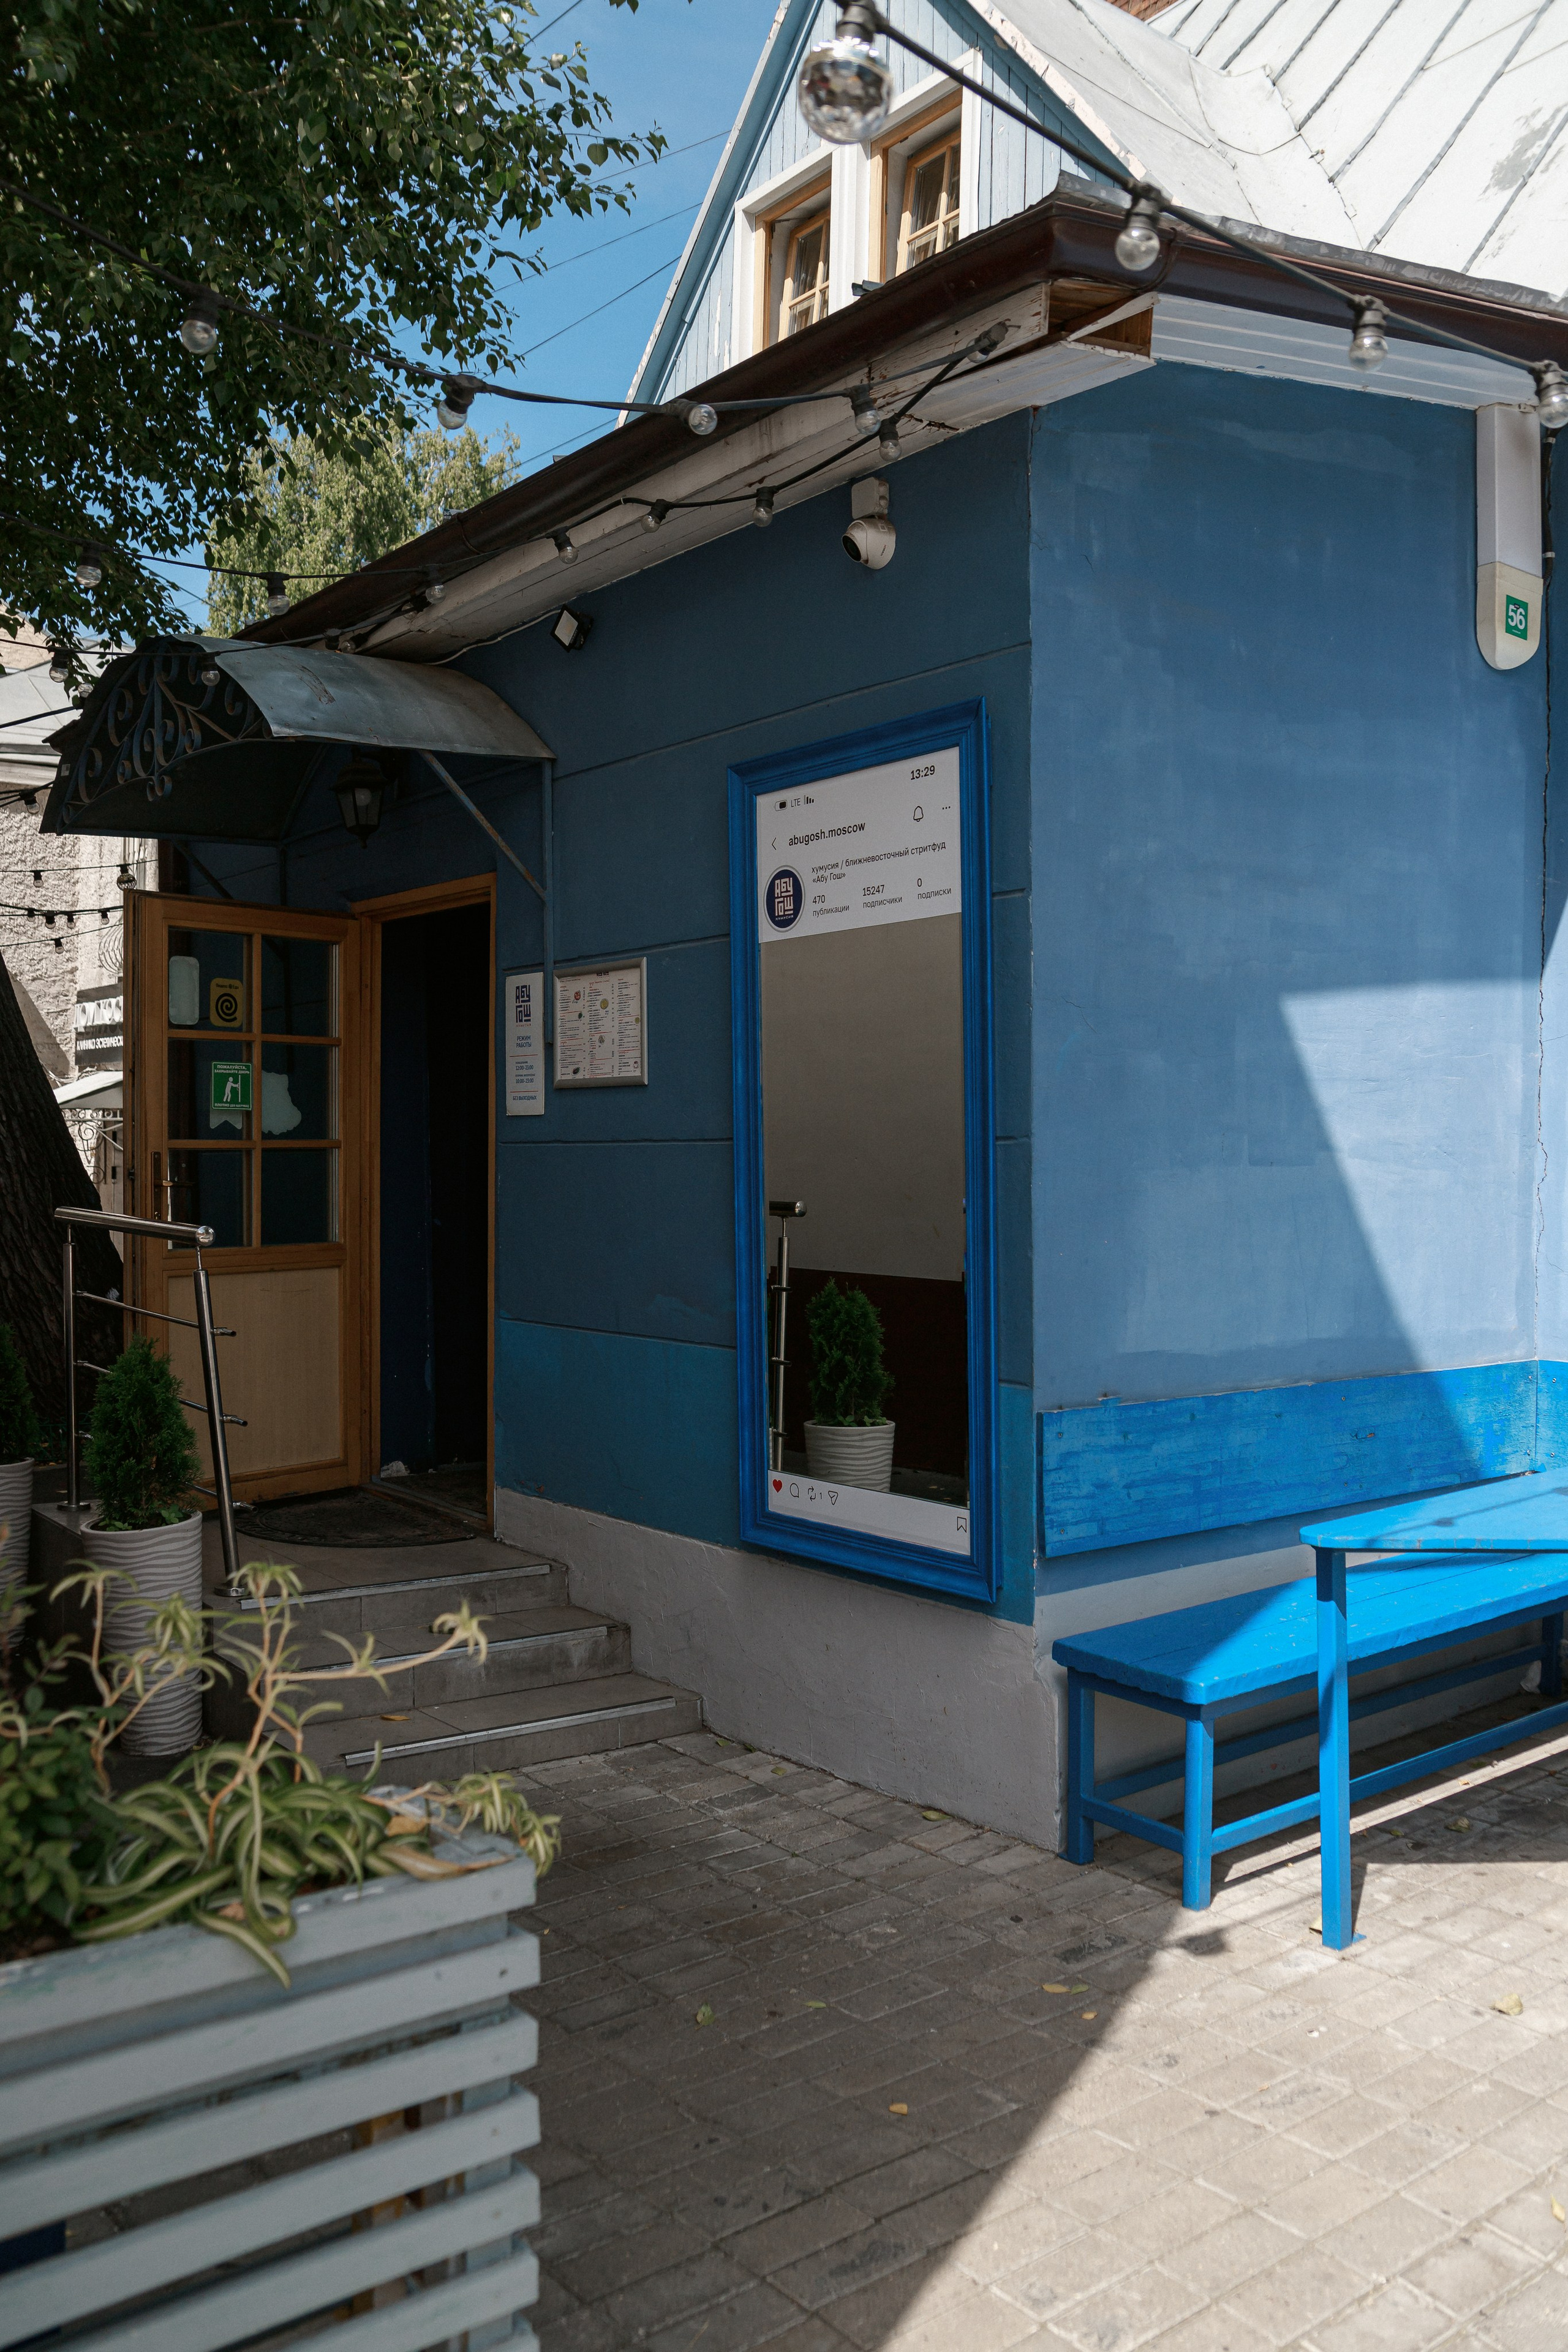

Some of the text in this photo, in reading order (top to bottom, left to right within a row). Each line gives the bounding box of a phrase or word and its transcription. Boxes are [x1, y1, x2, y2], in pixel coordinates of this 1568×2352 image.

[1507, 604, 1526, 630] 56
[910, 765, 935, 780] 13:29
[791, 798, 801, 808] LTE
[788, 822, 866, 846] abugosh.moscow
[812, 862, 839, 874] хумусия
[845, 848, 909, 867] ближневосточный
[911, 841, 946, 856] стритфуд
[812, 872, 846, 883] «Абу Гош»
[917, 878, 922, 888] 0
[862, 884, 885, 896] 15247
[917, 888, 952, 900] подписки
[812, 895, 826, 905] 470
[862, 896, 903, 909] подписчики
[813, 905, 850, 917] публикации
